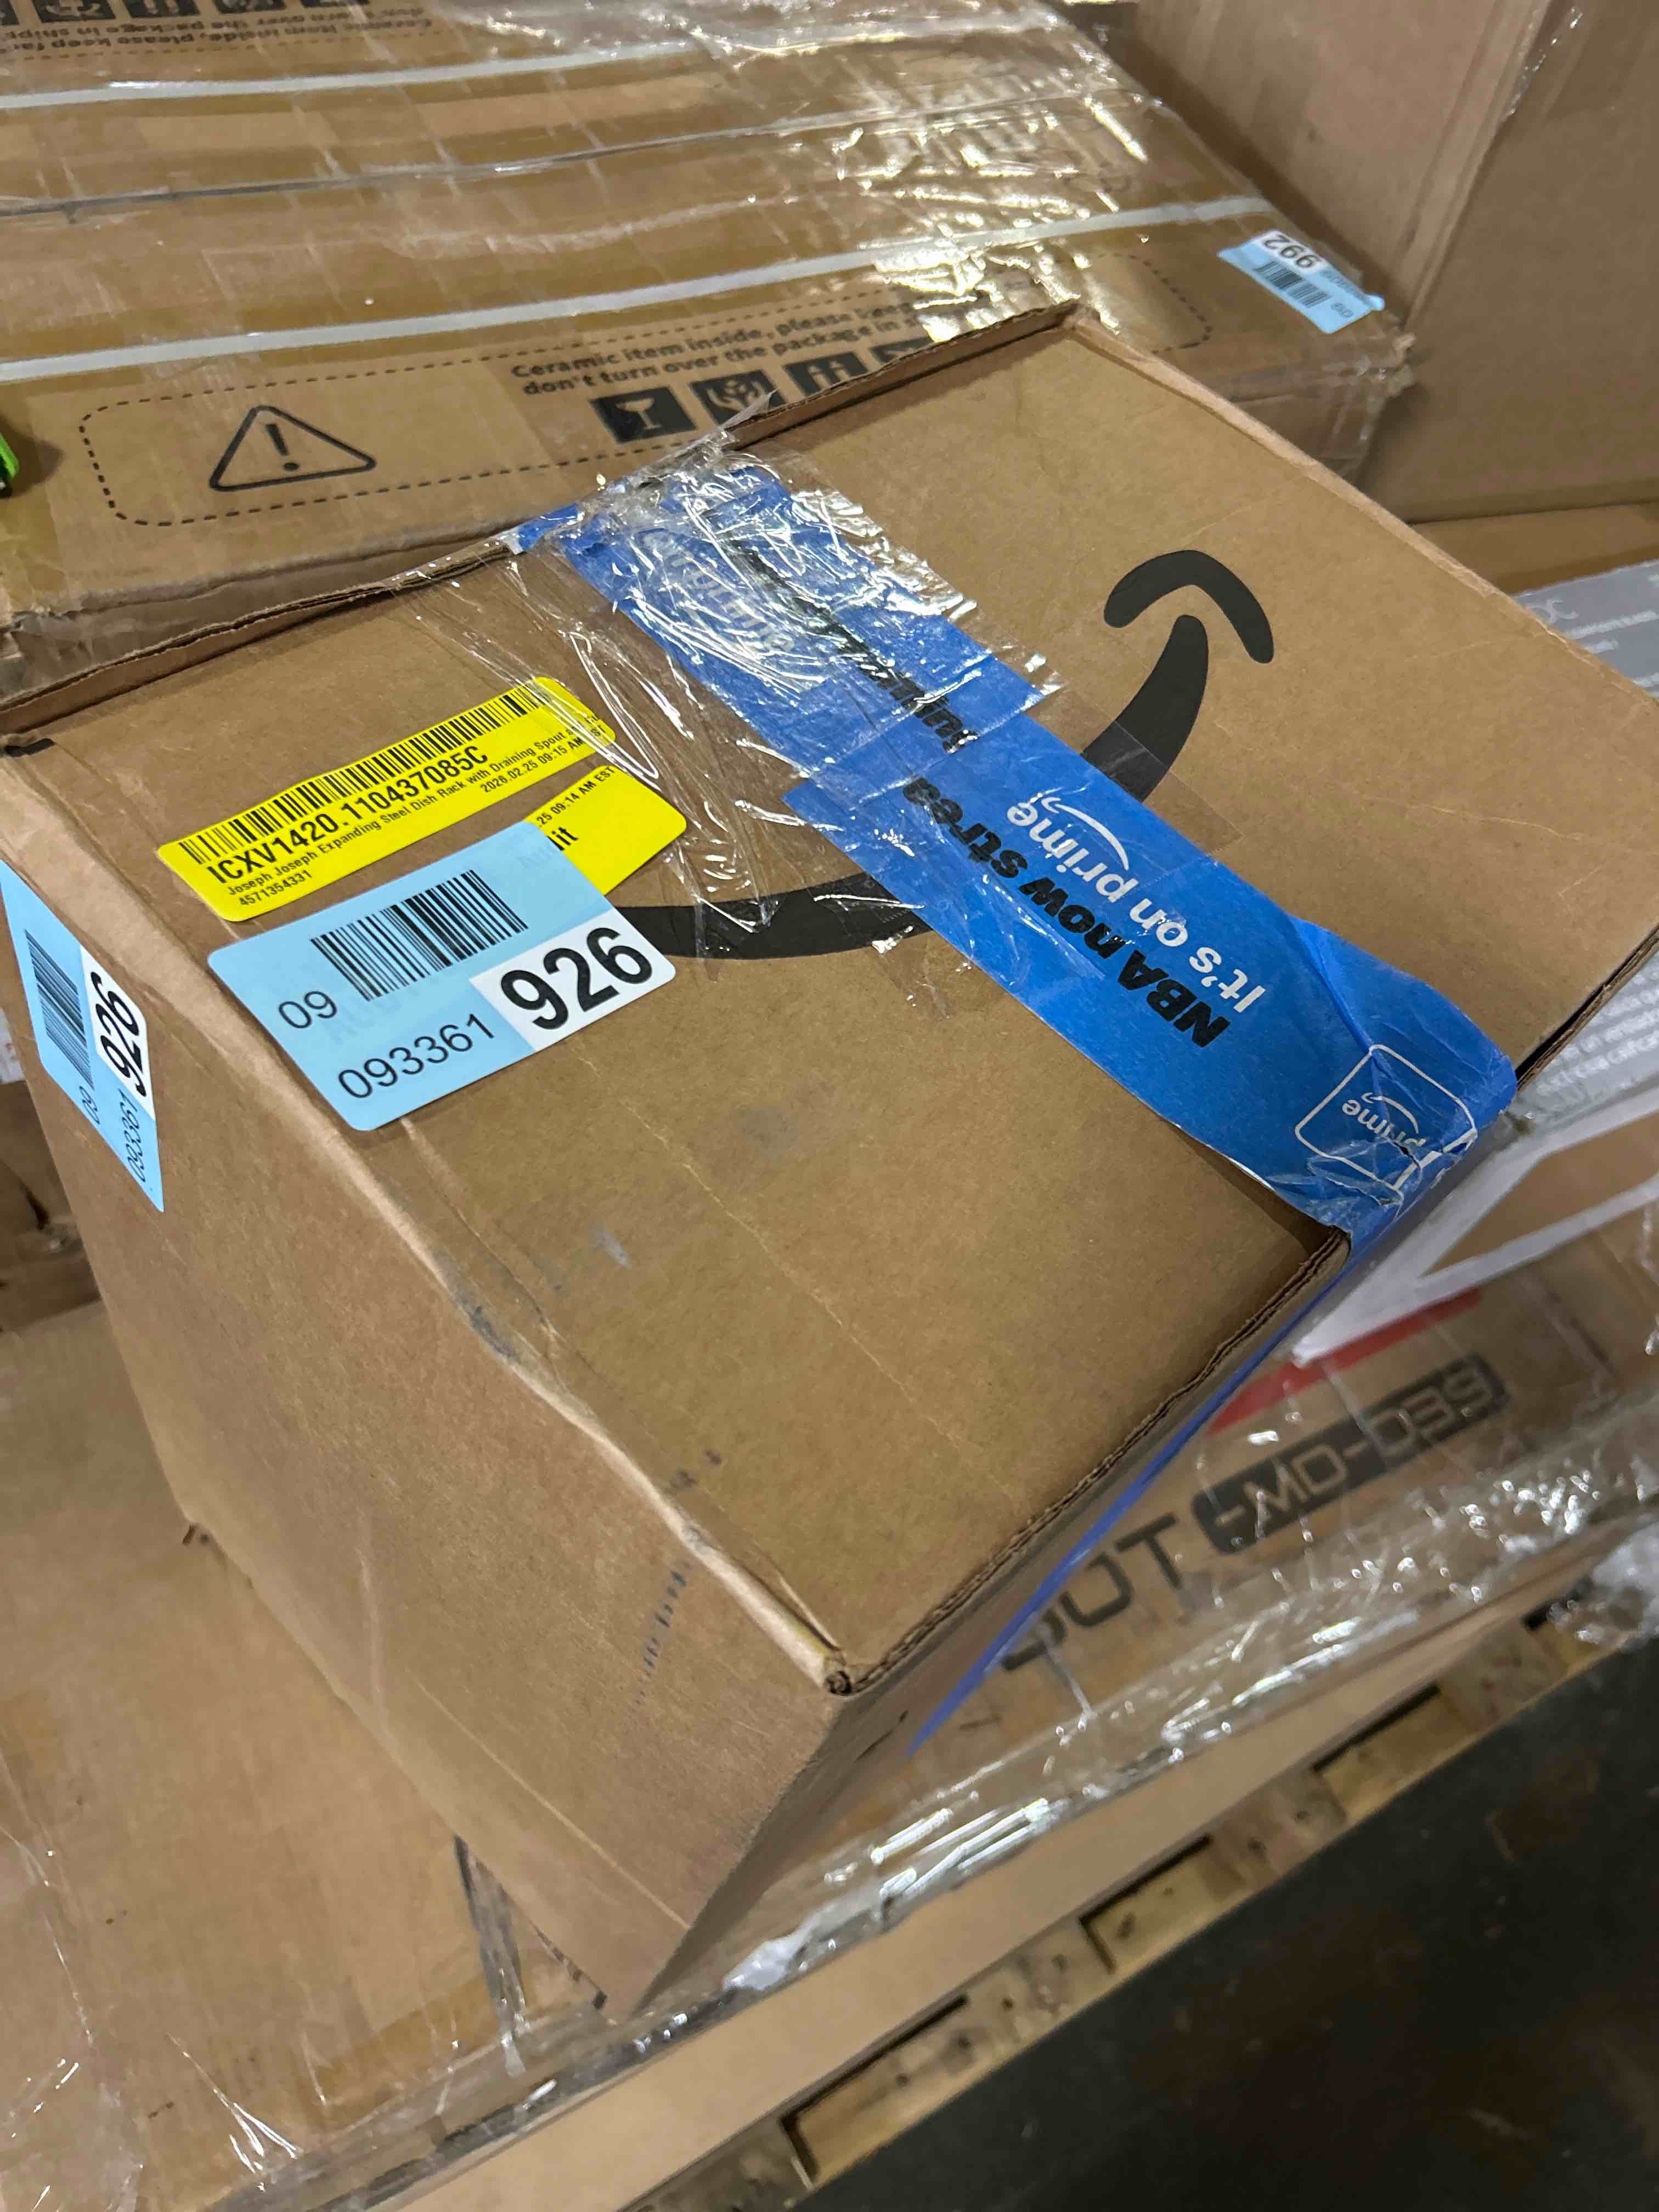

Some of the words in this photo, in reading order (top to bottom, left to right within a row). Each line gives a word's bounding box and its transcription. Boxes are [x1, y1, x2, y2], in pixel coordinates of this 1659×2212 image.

[1264, 234, 1319, 269] 992
[511, 353, 620, 378] Ceramic
[621, 344, 685, 362] item
[775, 314, 854, 336] please
[523, 373, 595, 396] don't
[597, 365, 660, 383] turn
[662, 355, 720, 374] over
[724, 342, 766, 363] the
[771, 326, 872, 357] package
[538, 745, 568, 765] 09:15
[227, 872, 273, 896] Joseph
[274, 850, 319, 877] Joseph
[317, 820, 382, 854] Expanding
[380, 806, 412, 824] Steel
[410, 794, 438, 811] Dish
[436, 780, 467, 799] Rack
[466, 767, 492, 785] with
[489, 746, 537, 772] Draining
[533, 731, 566, 751] Spout
[550, 792, 580, 815] 09:14
[578, 780, 597, 795] AM
[594, 766, 616, 782] EST
[903, 777, 1028, 878] strea
[1006, 802, 1139, 903] prime
[239, 870, 313, 906] 4571354331
[1018, 877, 1126, 959] now
[1129, 898, 1189, 947] on
[278, 991, 338, 1030] 09
[500, 927, 653, 1031] 926
[1118, 950, 1231, 1048] NBA
[1189, 946, 1266, 1013] It's
[90, 970, 148, 1098] 926
[338, 1013, 495, 1099] 093361
[78, 1085, 101, 1126] 09
[117, 1087, 147, 1183] 093361
